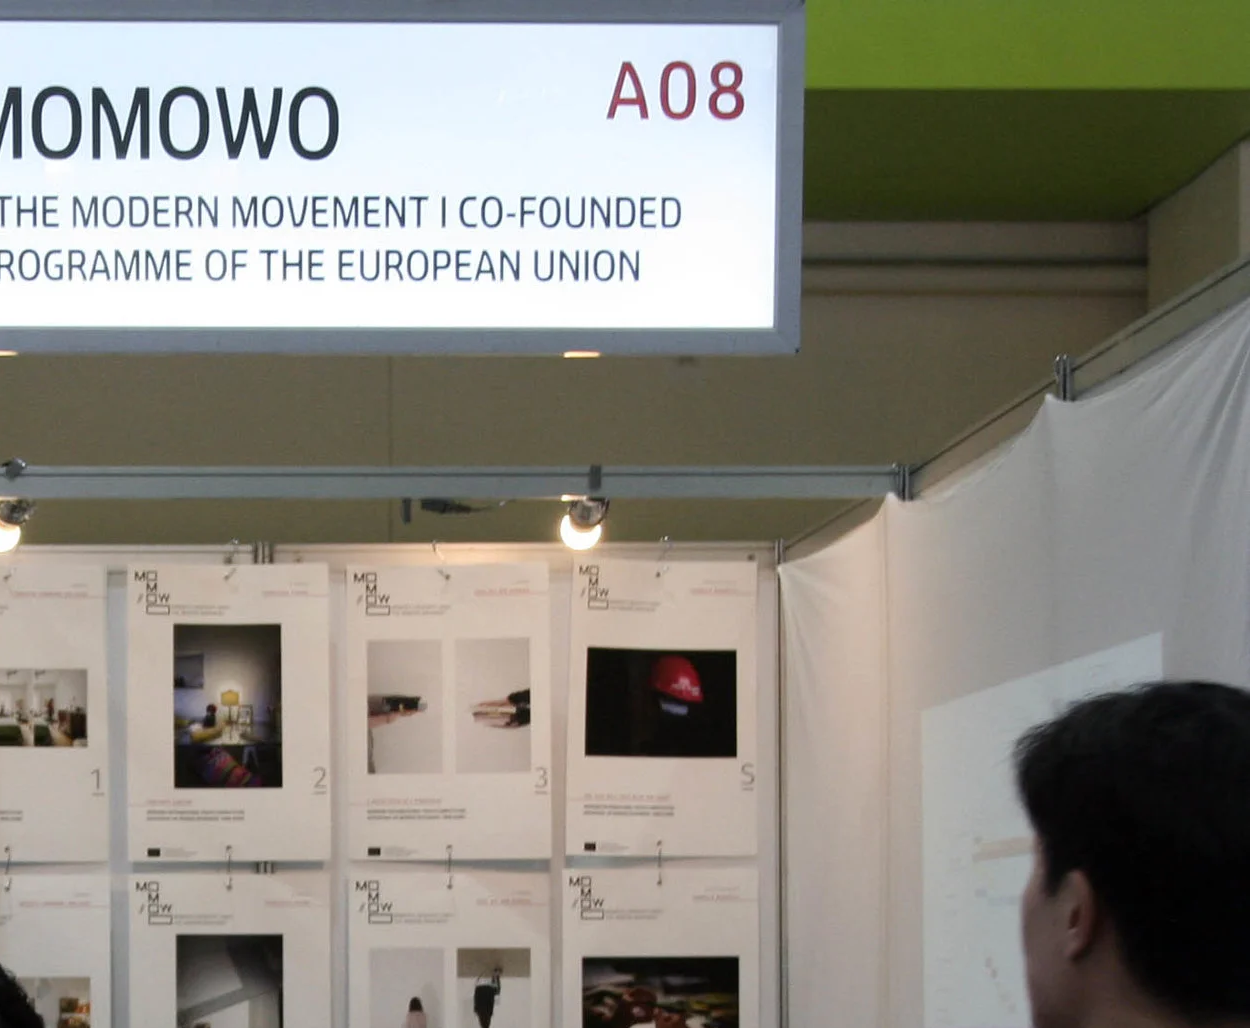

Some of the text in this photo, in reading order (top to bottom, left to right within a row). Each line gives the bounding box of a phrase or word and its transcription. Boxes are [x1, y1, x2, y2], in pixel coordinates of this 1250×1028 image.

[606, 60, 745, 121] A08
[72, 195, 218, 228] MODERN
[232, 195, 429, 228] MOVEMENT
[459, 195, 681, 229] CO-FOUNDED
[205, 249, 248, 282] OF
[259, 249, 325, 282] THE
[338, 249, 520, 282] EUROPEAN
[534, 249, 640, 282] UNION
